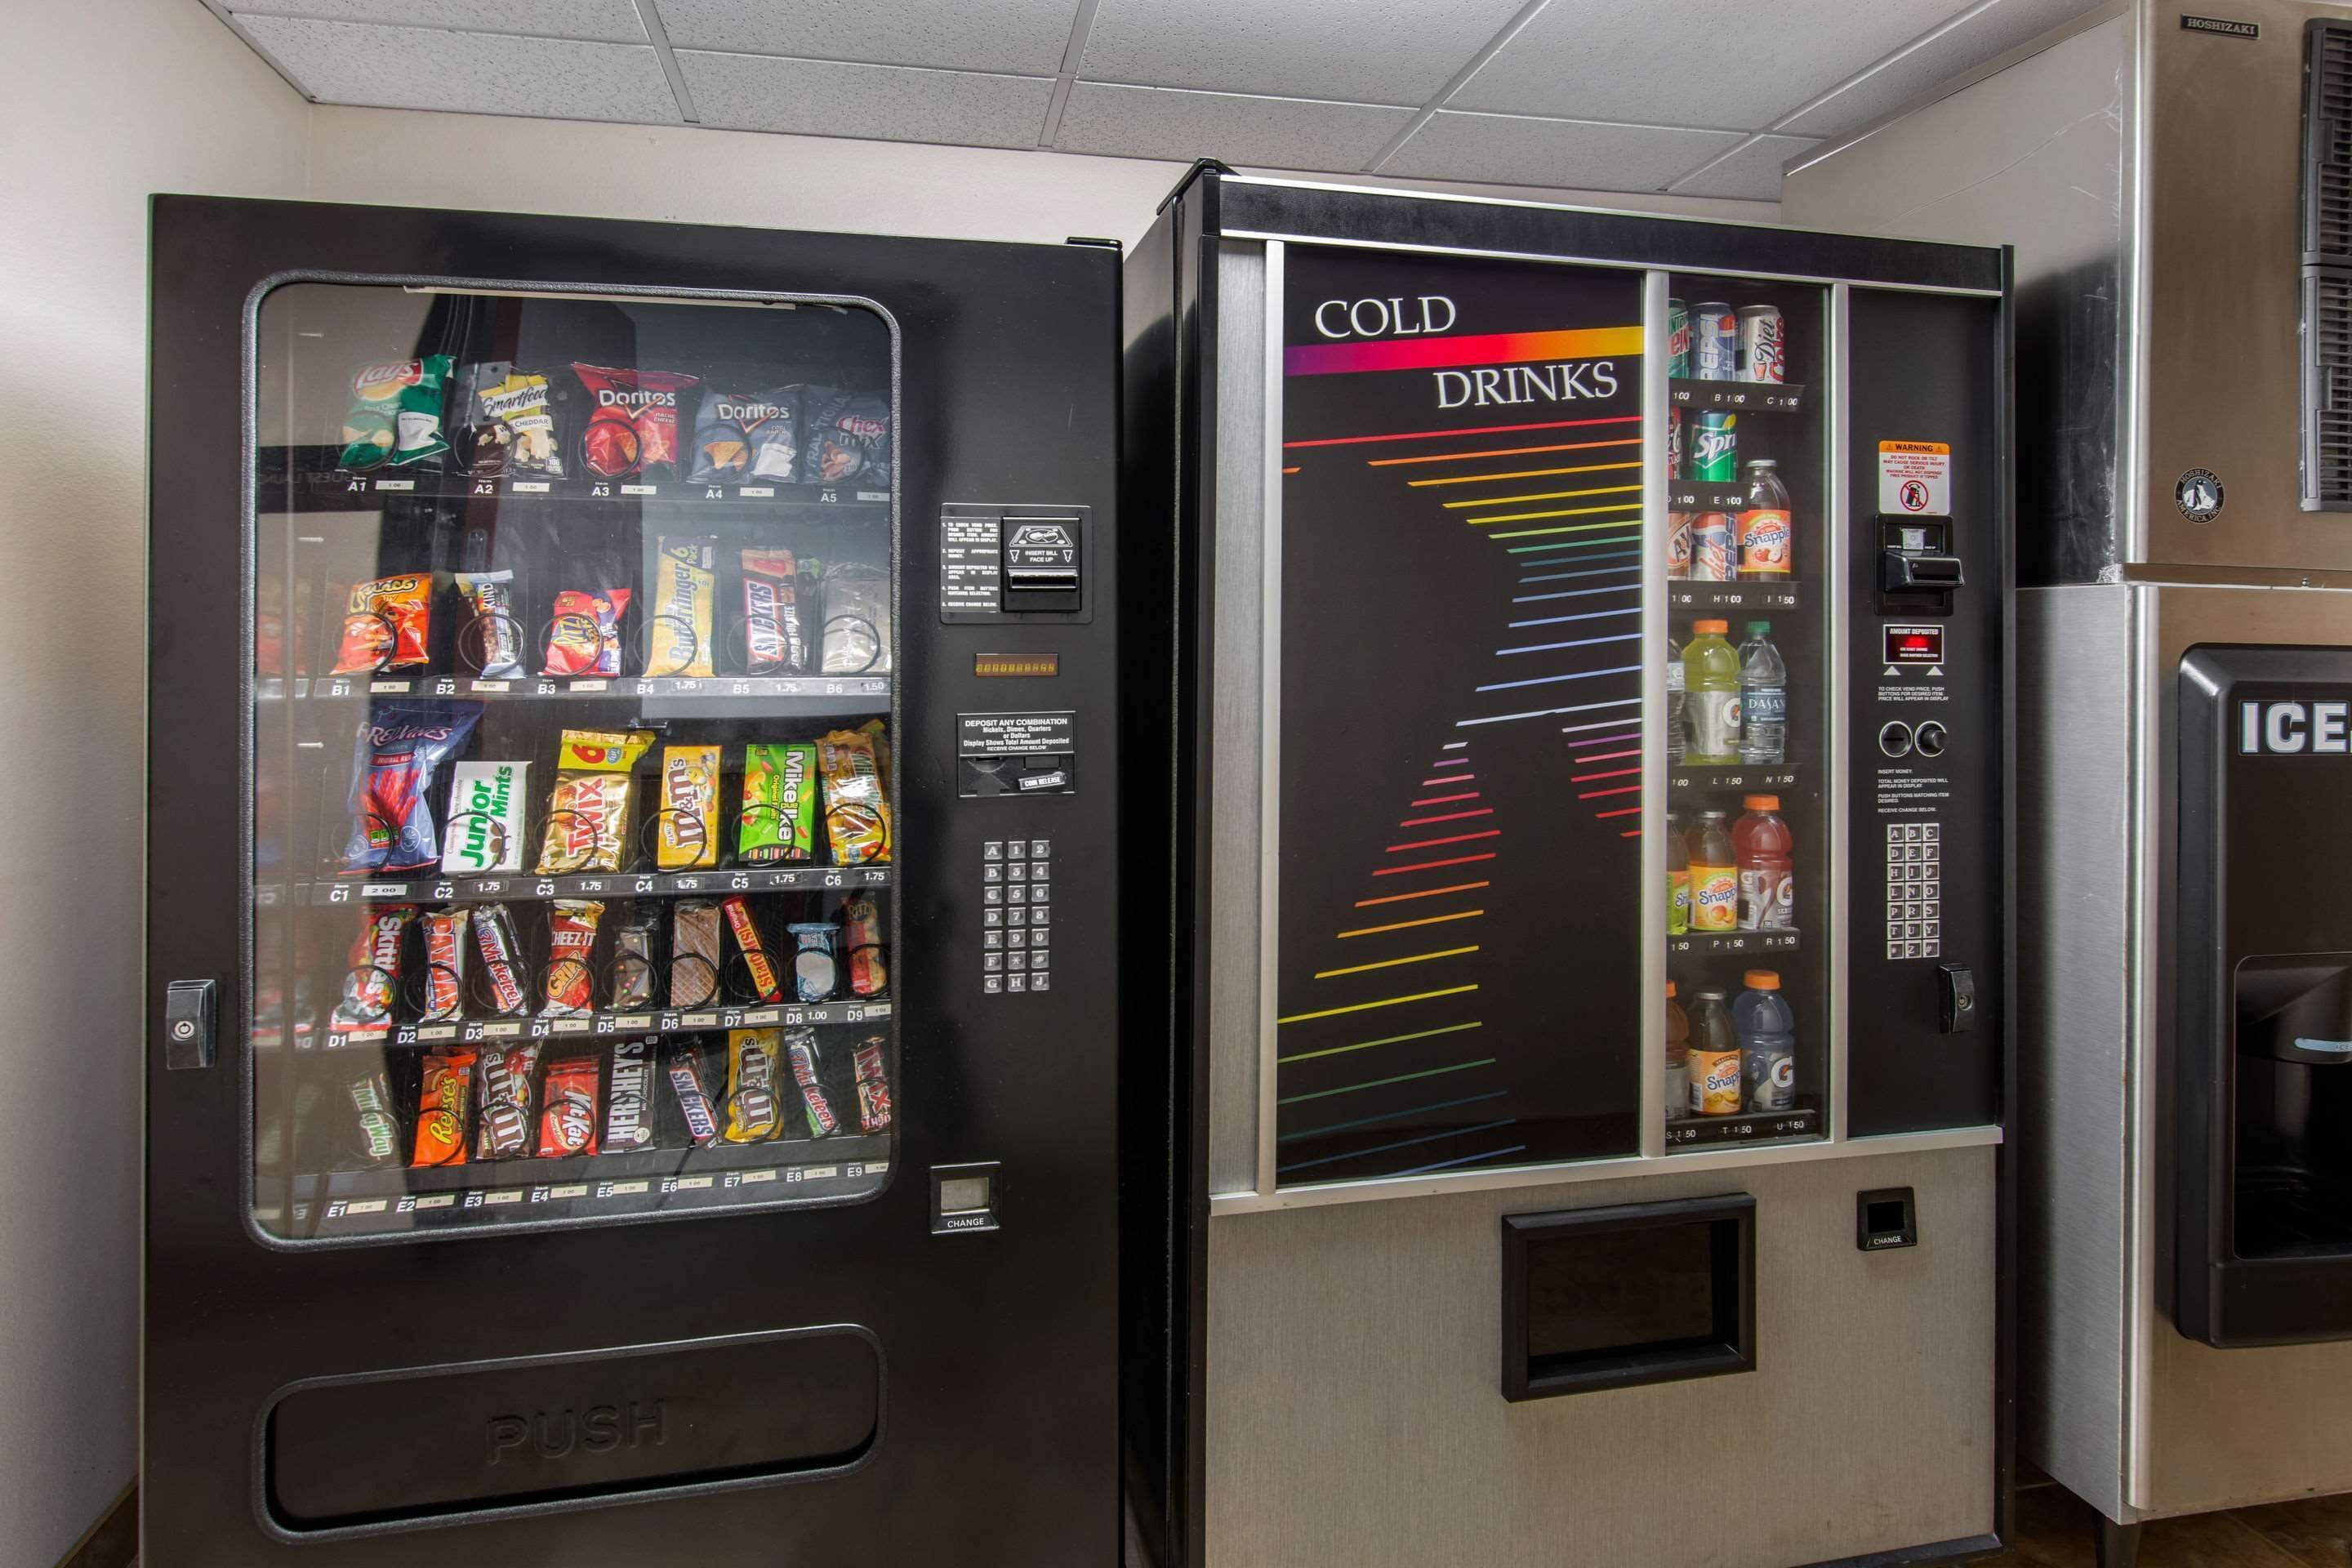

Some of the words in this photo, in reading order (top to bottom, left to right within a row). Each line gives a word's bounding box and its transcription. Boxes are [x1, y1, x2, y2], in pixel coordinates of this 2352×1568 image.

[2187, 18, 2255, 34] HOSHIZAKI
[1315, 296, 1456, 338] COLD
[1754, 318, 1775, 364] Diet
[1432, 361, 1619, 409] DRINKS
[599, 390, 675, 407] Doritos
[718, 403, 790, 420] Doritos
[514, 418, 549, 428] CHEDDAR
[1895, 443, 1934, 452] WARNING
[2180, 470, 2221, 489] HOSHIZAKI
[347, 481, 367, 491] A1
[474, 484, 493, 494] A2
[591, 487, 610, 497] A3
[706, 489, 723, 499] A4
[821, 493, 837, 502] A5
[2176, 499, 2207, 522] AMERICA
[1744, 523, 1790, 547] Snapple
[482, 583, 495, 609] KIND
[332, 684, 350, 696] B1
[436, 684, 455, 694] B2
[537, 684, 556, 694] B3
[637, 684, 654, 694] B4
[674, 680, 696, 690] 1.75
[733, 684, 750, 693] B5
[777, 683, 797, 693] 1.75
[826, 684, 843, 693] B6
[864, 682, 884, 691] 1.50
[2243, 702, 2347, 753] ICE
[782, 750, 804, 803] Mike
[1037, 777, 1061, 786] RELEASE
[489, 765, 514, 817] Mints
[769, 774, 780, 800] Original
[461, 780, 492, 868] Junior
[777, 808, 799, 841] Ike
[1926, 829, 1933, 837] C
[987, 846, 998, 855] A
[1013, 845, 1020, 854] 1
[1036, 844, 1044, 853] 2
[1909, 849, 1916, 857] E
[988, 868, 997, 877] B
[1012, 867, 1021, 876] 3
[1036, 866, 1045, 875] 4
[731, 878, 749, 889] C5
[774, 874, 795, 884] 1.75
[825, 875, 842, 886] C6
[865, 872, 885, 881] 1.75
[434, 887, 453, 898] C2
[477, 883, 500, 893] 1.75
[537, 884, 555, 895] C3
[581, 881, 602, 891] 1.75
[635, 881, 653, 893] C4
[676, 880, 697, 889] 1.75
[330, 890, 349, 902] C1
[987, 890, 997, 899] C
[1013, 889, 1021, 898] 5
[1036, 889, 1044, 898] 6
[987, 912, 998, 922] D
[1013, 911, 1020, 920] 7
[1036, 911, 1044, 920] 8
[987, 934, 997, 944] E
[1012, 933, 1020, 943] 9
[1036, 933, 1044, 941] 0
[364, 916, 403, 996] Skittles
[987, 957, 997, 966] F
[430, 918, 459, 1012] PAYDAY
[987, 979, 997, 988] G
[1011, 978, 1021, 987] H
[1036, 976, 1043, 986] J
[724, 1015, 742, 1027] D7
[786, 1013, 803, 1024] D8
[807, 1011, 827, 1020] 1.00
[847, 1010, 863, 1021] D9
[597, 1022, 615, 1033] D5
[661, 1018, 679, 1030] D6
[465, 1028, 483, 1040] D3
[532, 1025, 550, 1036] D4
[328, 1036, 347, 1047] D1
[397, 1032, 416, 1044] D2
[608, 1042, 644, 1141] HERSHEY'S
[429, 1076, 458, 1145] Reese's
[786, 1172, 802, 1183] E8
[847, 1166, 862, 1177] E9
[661, 1182, 677, 1193] E6
[724, 1177, 740, 1187] E7
[531, 1191, 549, 1202] E4
[596, 1187, 613, 1198] E5
[396, 1201, 415, 1213] E2
[464, 1196, 483, 1208] E3
[327, 1206, 345, 1218] E1
[947, 1218, 985, 1228] CHANGE
[1873, 1236, 1902, 1245] CHANGE
[486, 1398, 666, 1465] PUSH
